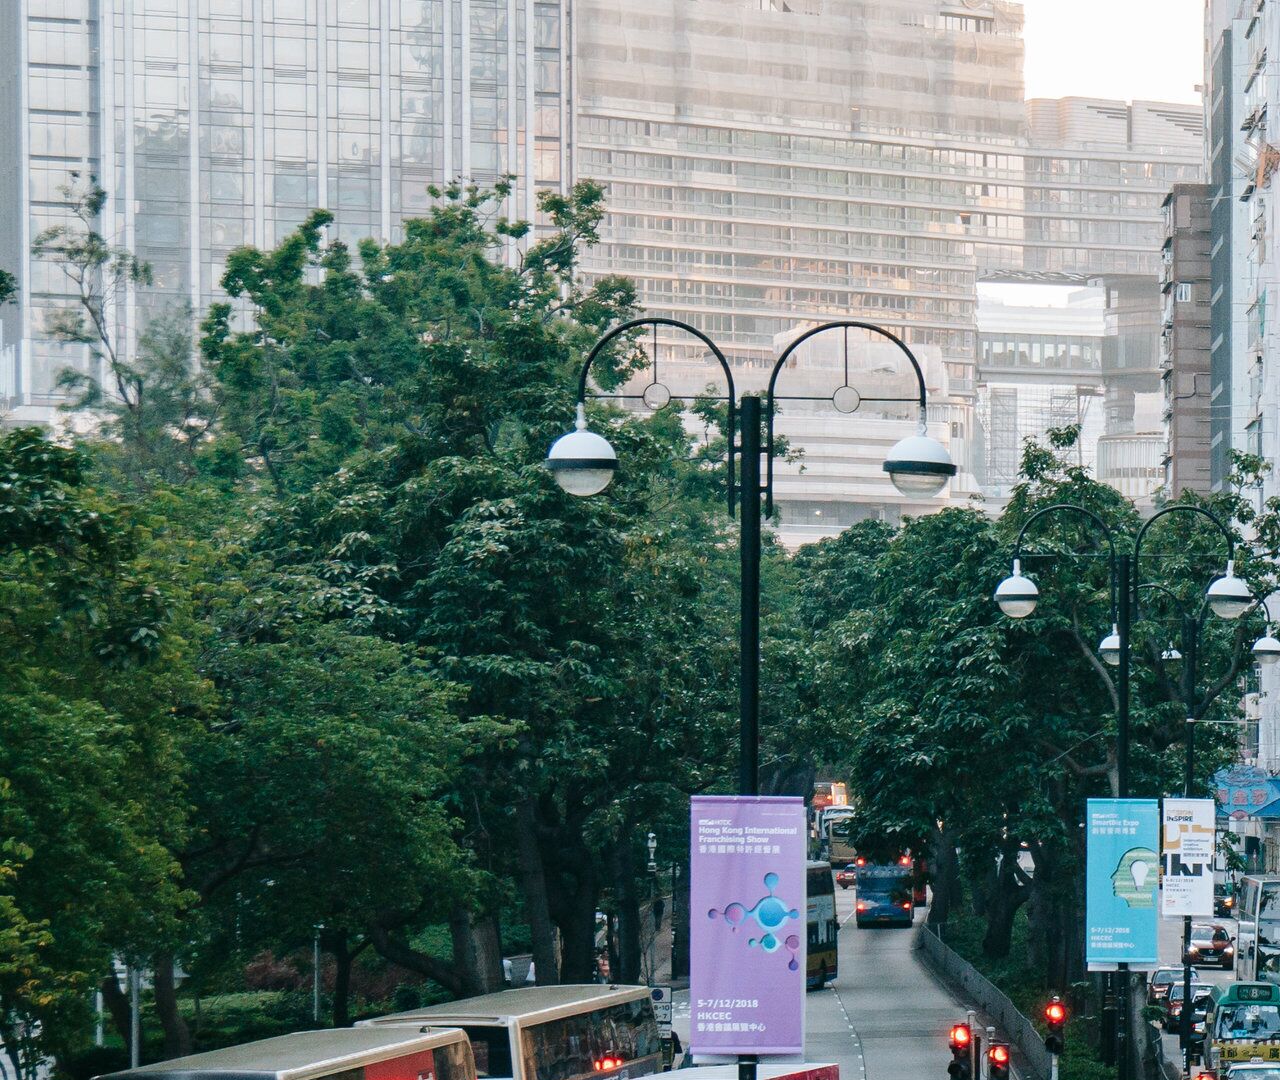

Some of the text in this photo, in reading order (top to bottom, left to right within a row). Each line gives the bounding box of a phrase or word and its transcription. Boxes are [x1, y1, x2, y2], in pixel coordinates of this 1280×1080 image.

[699, 826, 798, 836] Hong Kong International
[699, 835, 769, 845] Franchising Show
[697, 999, 759, 1009] 5-7/12/2018
[697, 1012, 732, 1020] HKCEC
